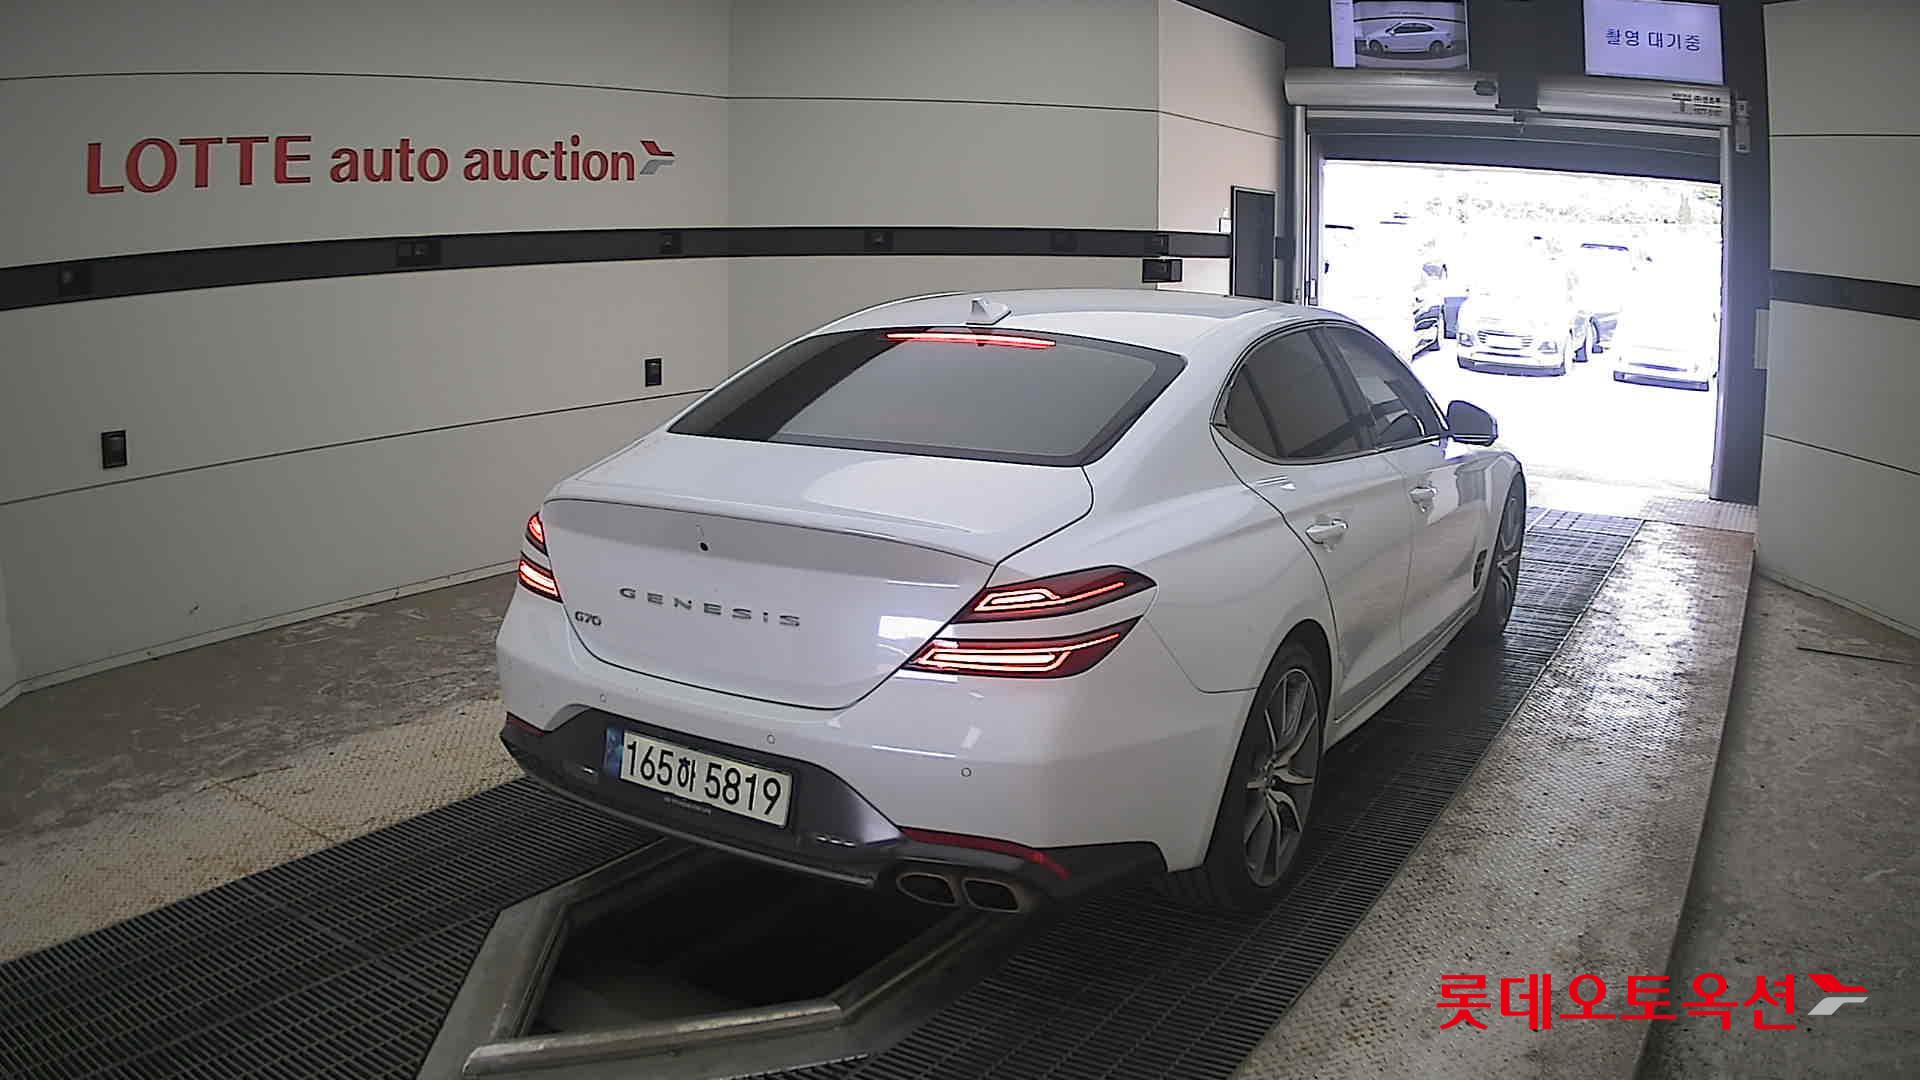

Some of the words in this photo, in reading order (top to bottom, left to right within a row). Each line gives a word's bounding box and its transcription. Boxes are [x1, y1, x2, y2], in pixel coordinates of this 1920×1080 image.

[1606, 28, 1640, 48] 촬영
[1648, 31, 1700, 52] 대기중
[86, 135, 312, 195] LOTTE
[329, 138, 449, 183] auto
[463, 134, 635, 183] auction
[574, 610, 603, 627] G70
[619, 587, 801, 628] GENESIS
[627, 740, 696, 793] 165하
[704, 762, 782, 816] 5819
